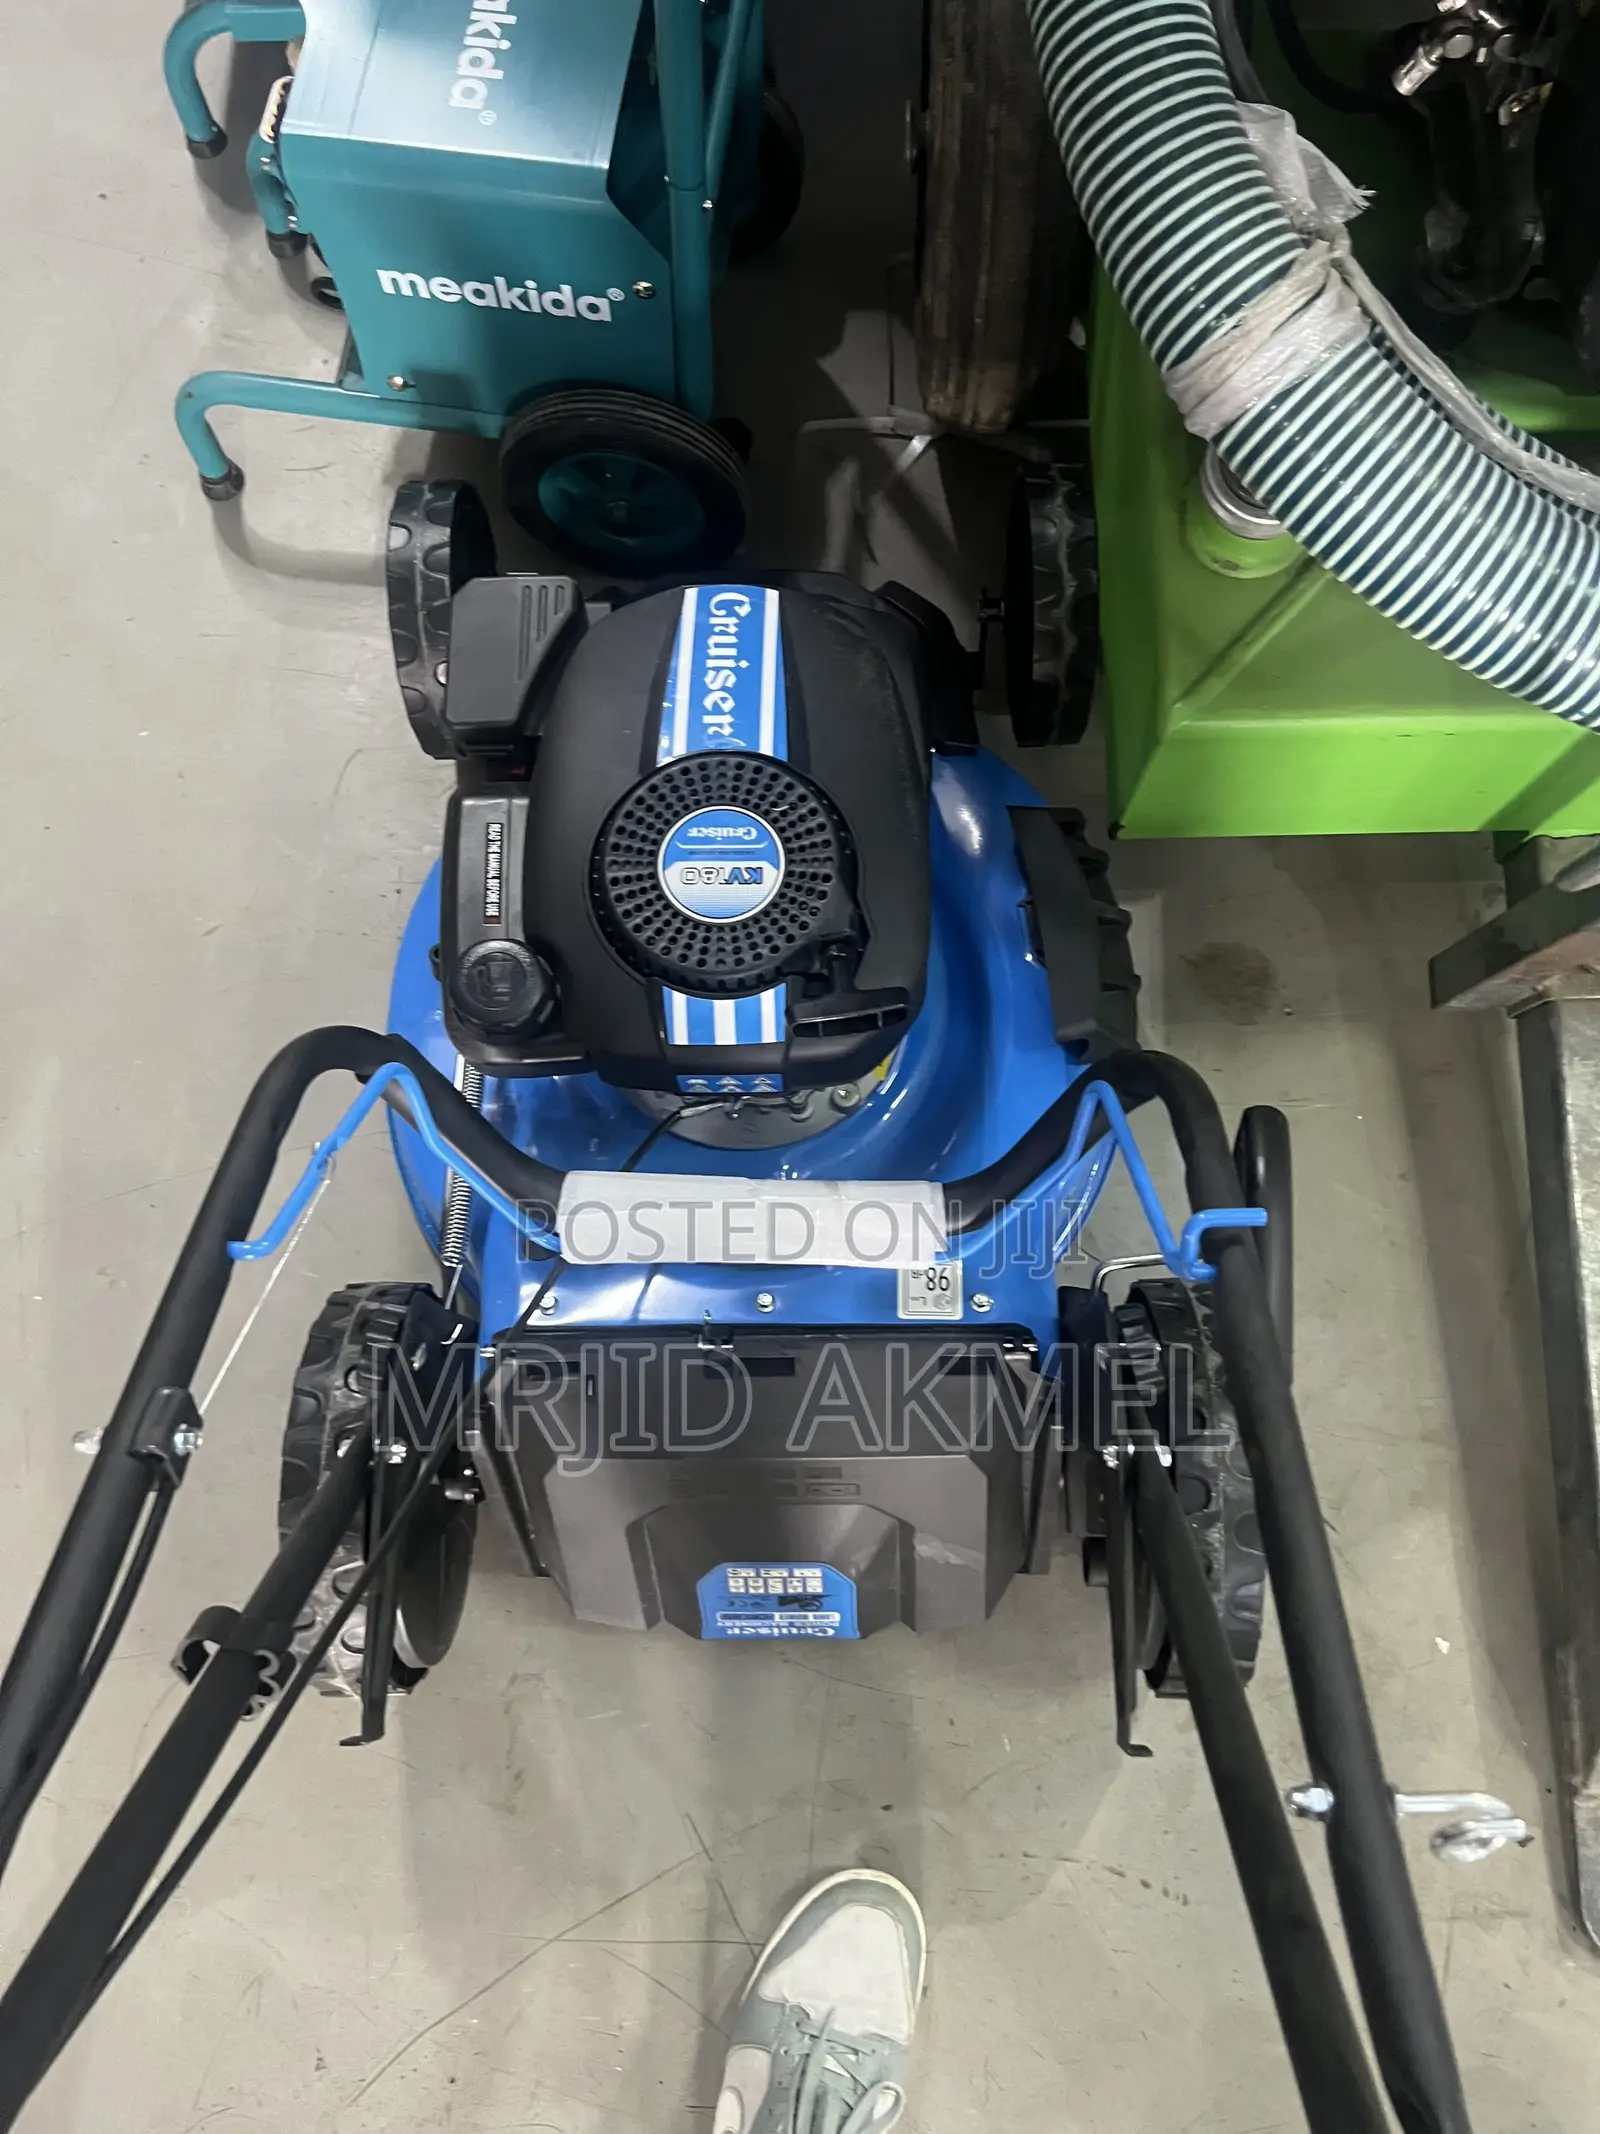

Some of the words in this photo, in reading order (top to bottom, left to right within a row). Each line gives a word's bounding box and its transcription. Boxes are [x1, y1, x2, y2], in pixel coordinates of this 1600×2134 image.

[702, 591, 752, 736] Cruiser
[488, 823, 501, 840] READ
[686, 825, 759, 841] Cruiser
[488, 841, 501, 853] THE
[486, 853, 500, 878] MANUAL
[680, 866, 764, 886] KV180
[486, 878, 499, 903] BEFORE
[485, 903, 499, 916] USE
[926, 1267, 951, 1292] 98
[726, 1626, 836, 1637] Cruiser
